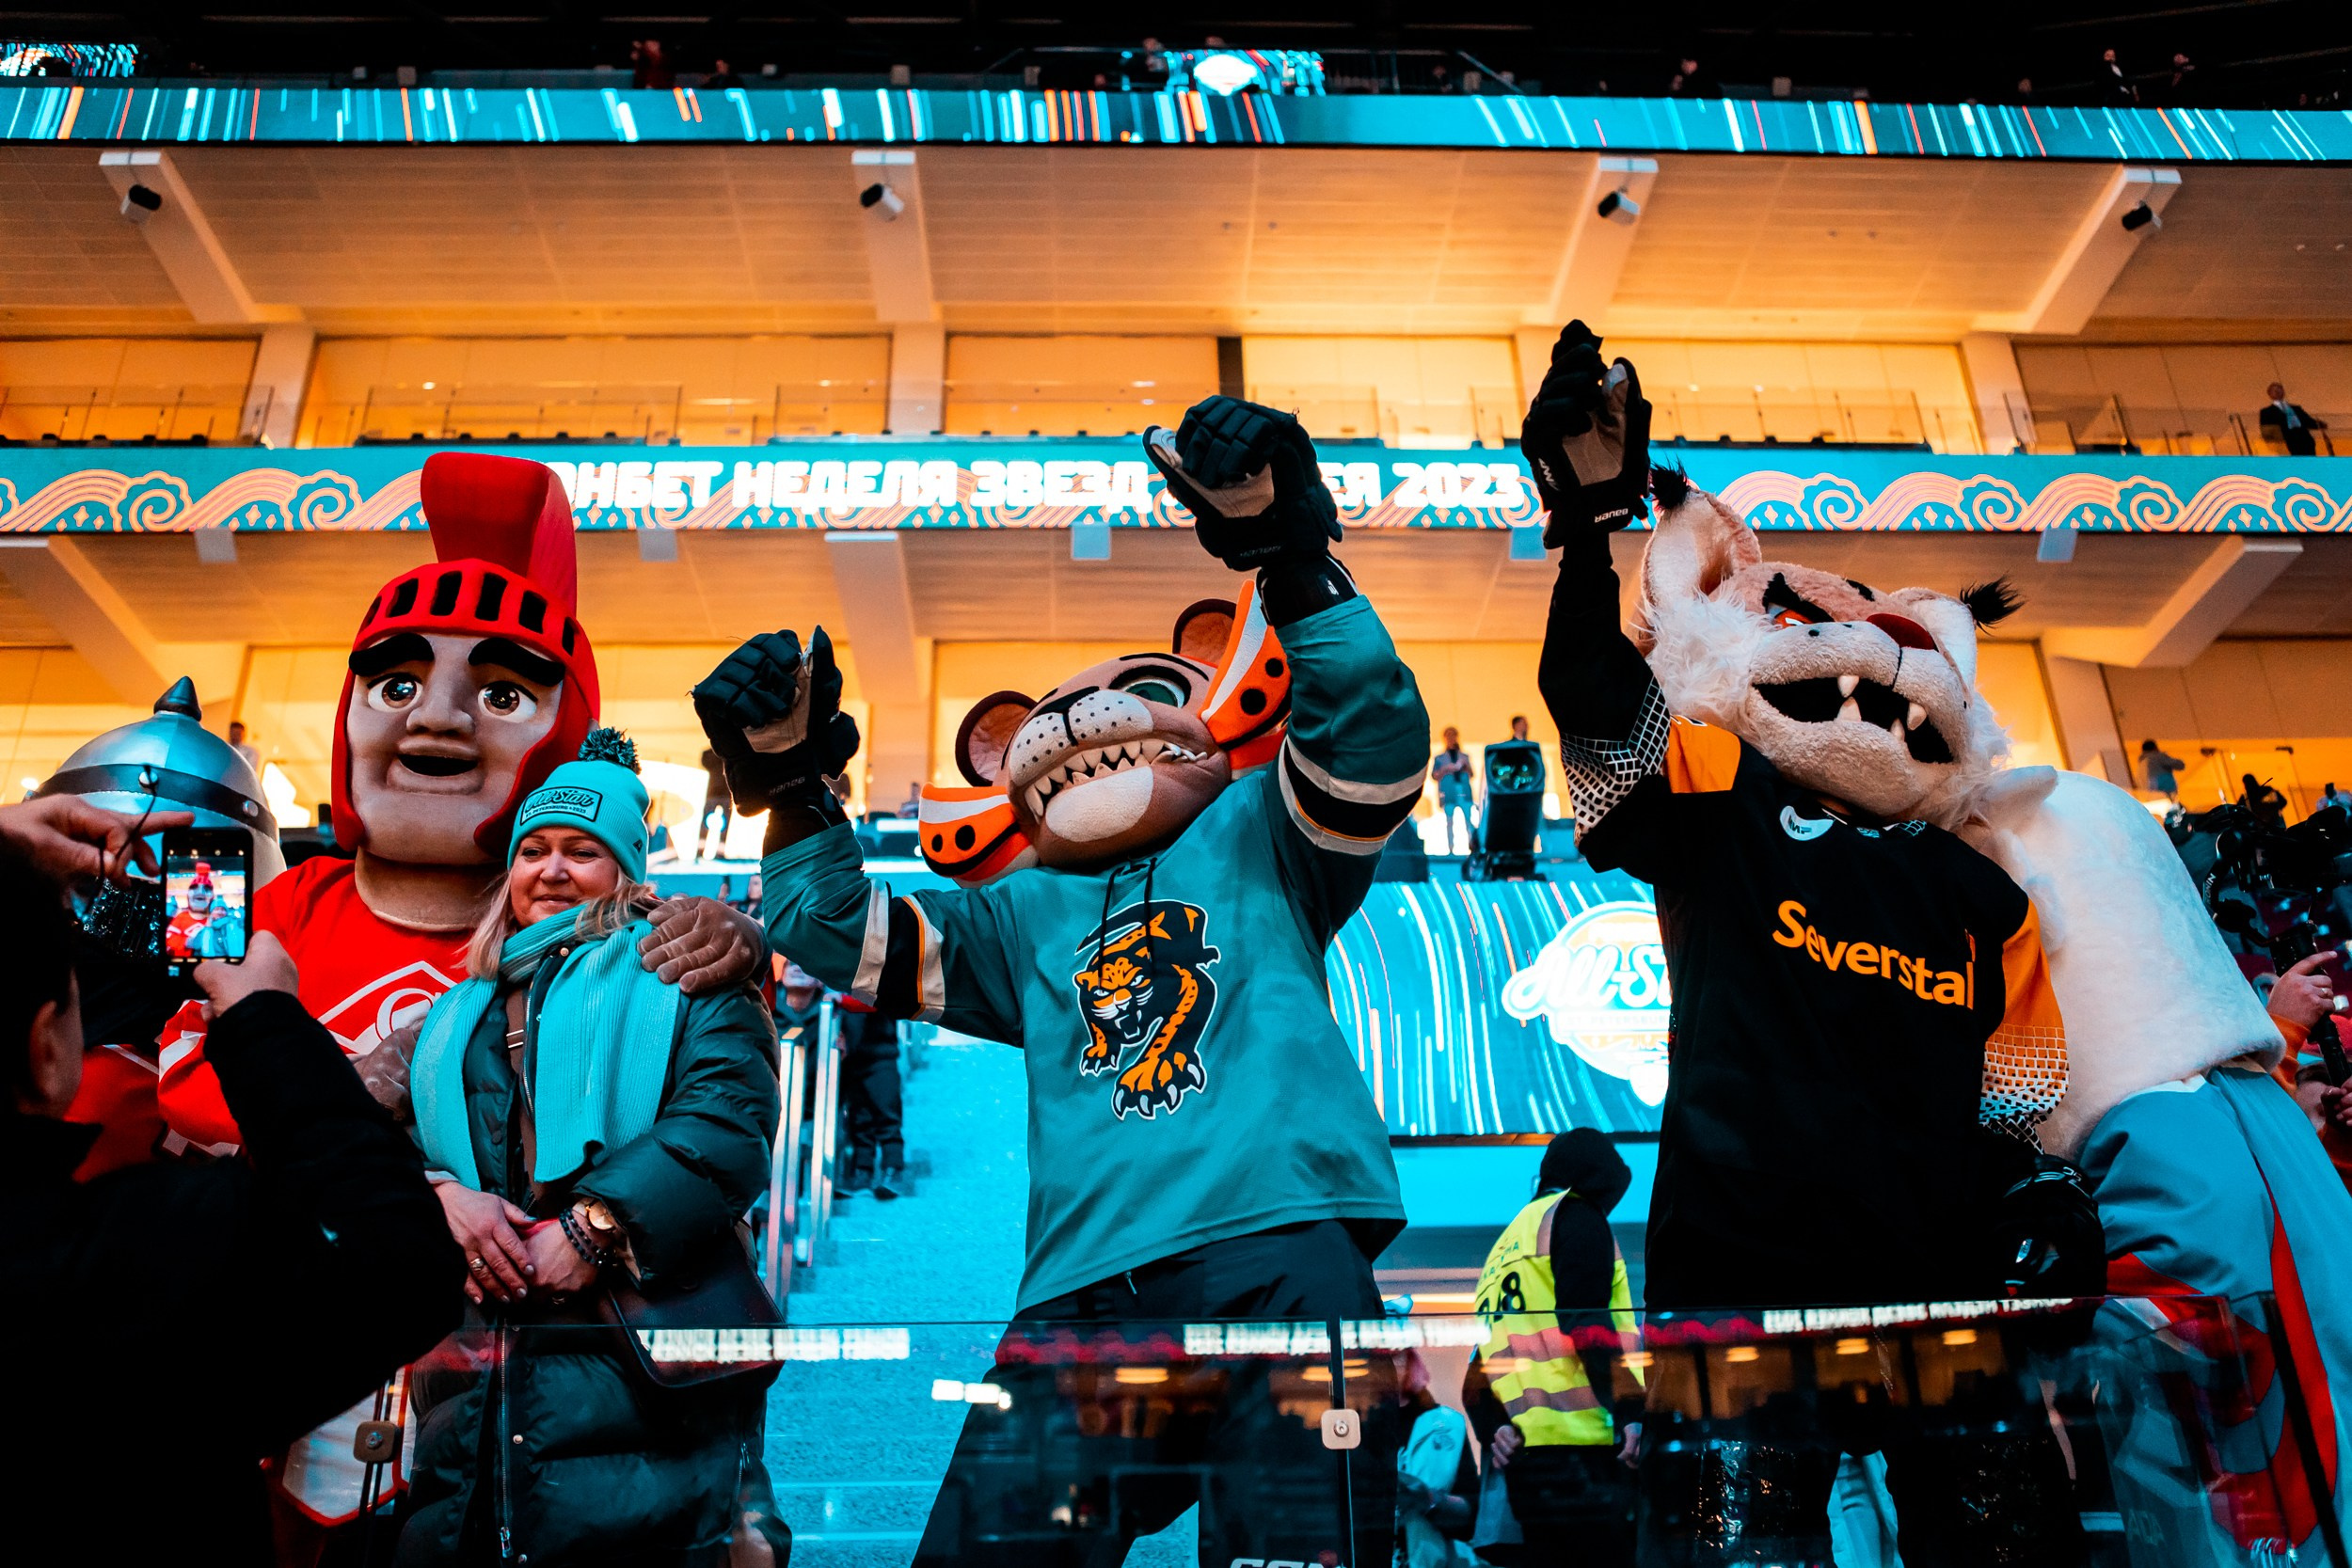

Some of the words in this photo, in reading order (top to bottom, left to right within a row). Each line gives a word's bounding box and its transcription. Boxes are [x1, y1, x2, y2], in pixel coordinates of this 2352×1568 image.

[539, 461, 723, 509] ОНБЕТ
[732, 461, 958, 515] НЕДЕЛЯ
[969, 461, 1153, 514] ЗВЕЗД
[1392, 462, 1524, 508] 2023
[1772, 900, 1974, 1010] Severstal
